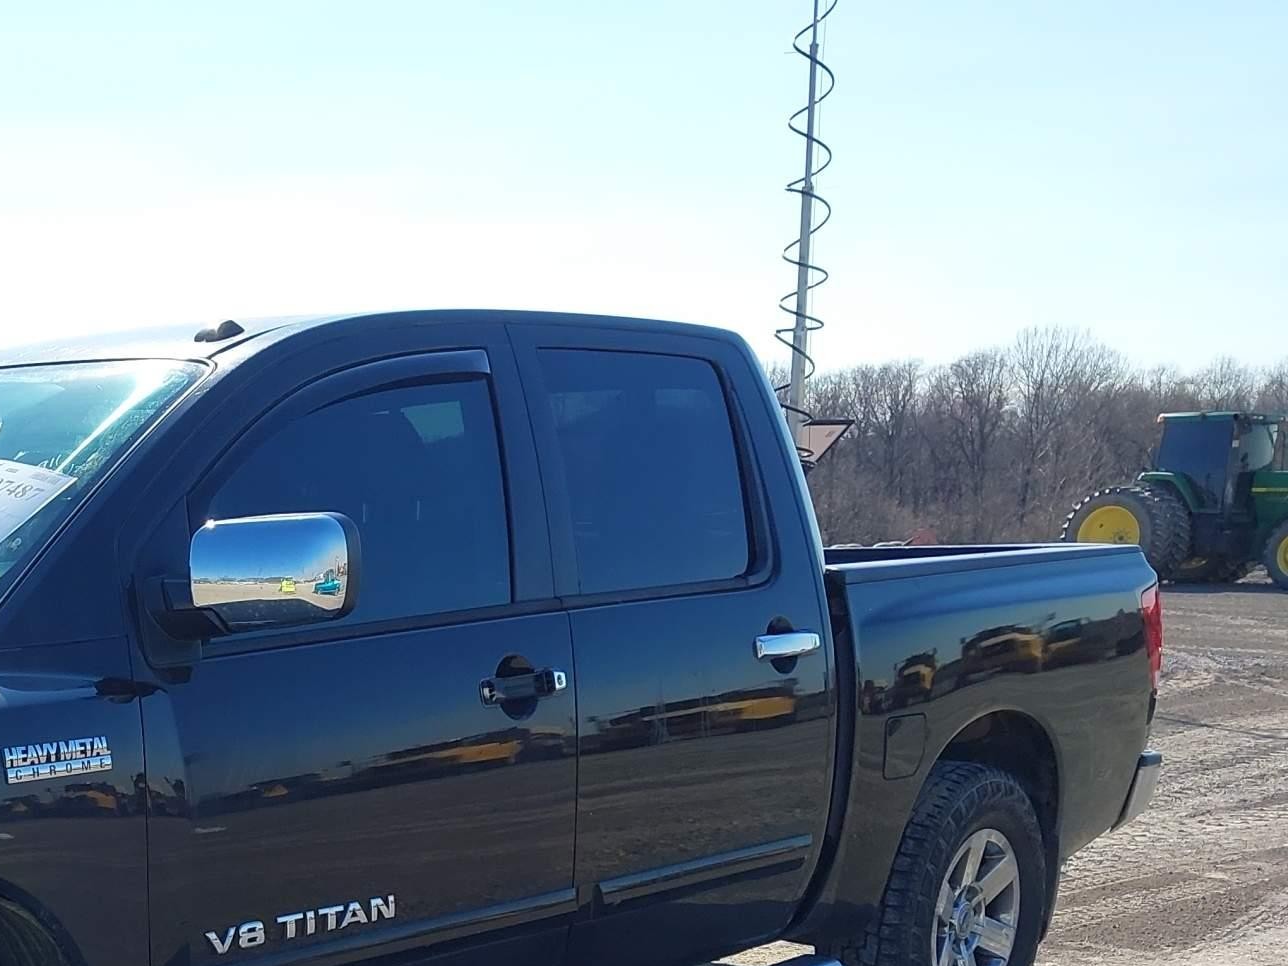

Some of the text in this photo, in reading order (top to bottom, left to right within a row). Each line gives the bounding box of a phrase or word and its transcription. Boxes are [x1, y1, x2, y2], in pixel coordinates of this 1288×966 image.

[15, 757, 107, 780] CHROME
[204, 894, 396, 955] V8 TITAN
